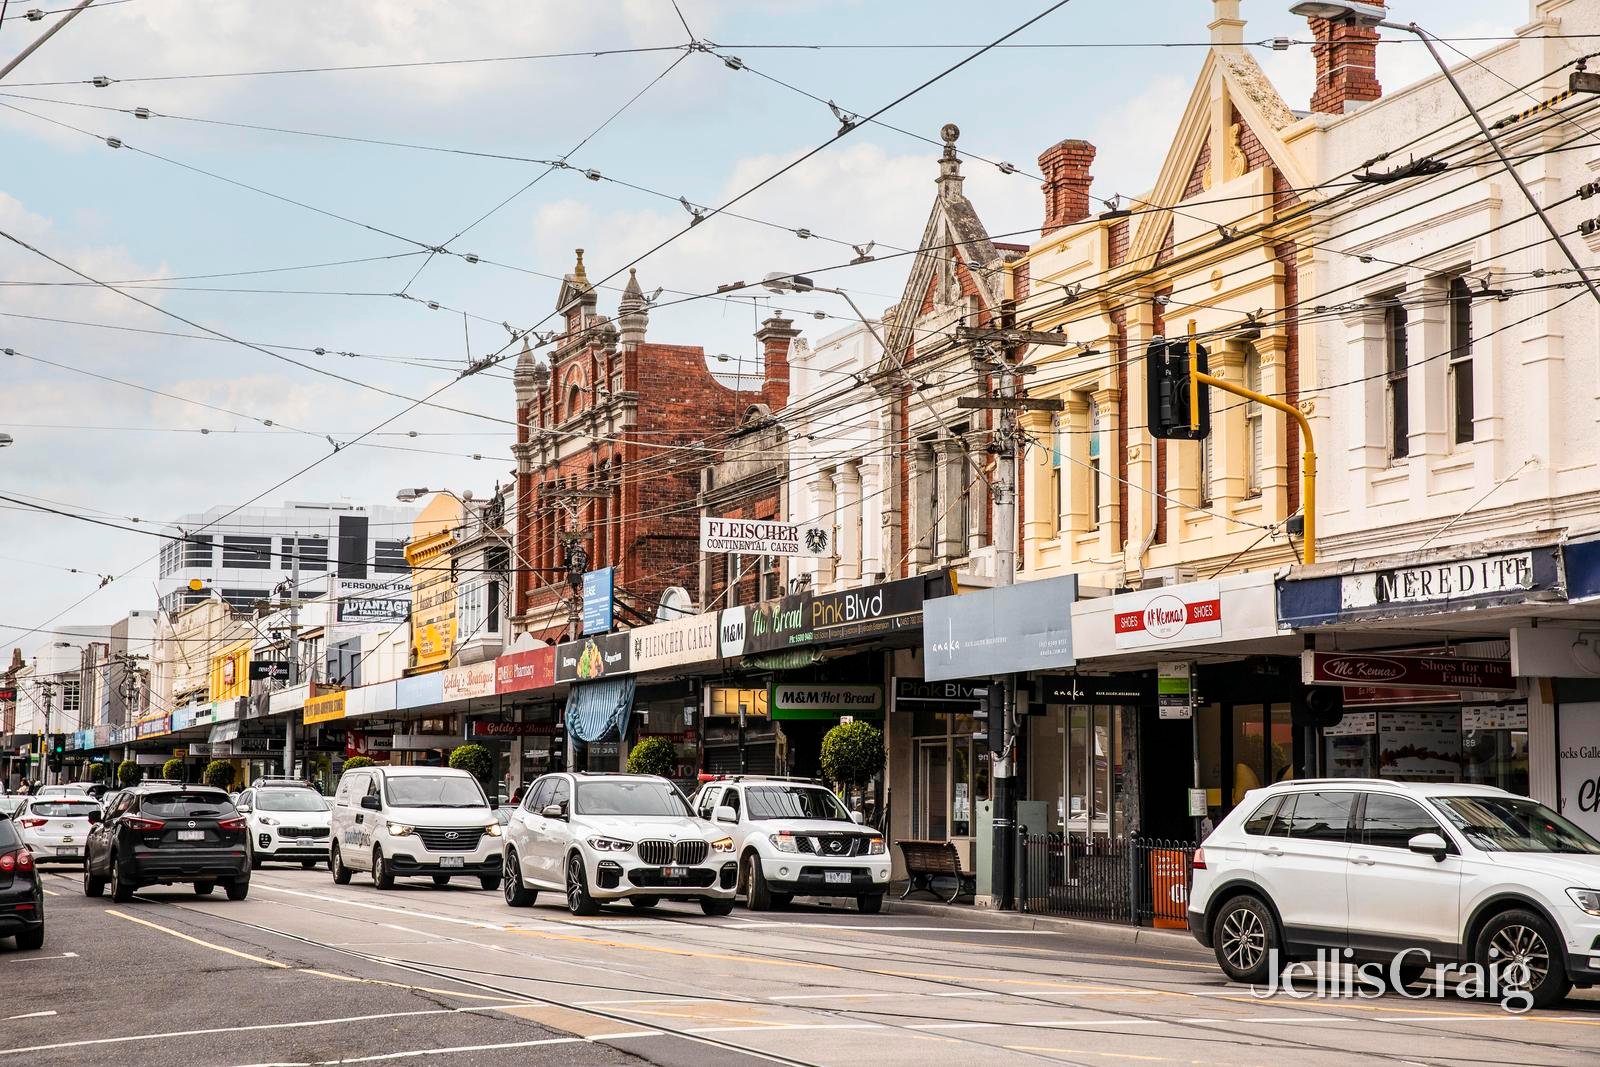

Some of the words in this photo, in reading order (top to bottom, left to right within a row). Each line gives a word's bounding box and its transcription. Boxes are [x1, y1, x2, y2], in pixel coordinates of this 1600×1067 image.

[708, 521, 800, 541] FLEISCHER
[707, 539, 767, 552] CONTINENTAL
[770, 542, 799, 553] CAKES
[341, 582, 388, 590] PERSONAL
[812, 598, 844, 627] Pink
[845, 589, 883, 620] Blvd
[1194, 605, 1213, 618] SHOES
[773, 602, 803, 633] Bread
[1121, 616, 1138, 628] SHOES
[722, 623, 744, 643] M&M
[932, 617, 960, 661] anaka
[645, 630, 684, 658] FLEISCHER
[688, 624, 713, 651] CAKES
[514, 664, 535, 678] Pharmacy
[1333, 661, 1353, 675] Mc
[1356, 662, 1397, 677] Kennas
[1420, 660, 1456, 672] Shoes
[1461, 661, 1480, 673] for
[1485, 662, 1504, 674] the
[443, 674, 466, 693] Goldy's
[466, 671, 493, 690] Boutique
[1442, 672, 1483, 687] Family
[901, 682, 942, 697] Pink
[945, 683, 975, 697] Blv
[1054, 679, 1085, 700] anaka
[781, 691, 820, 704] M&M
[820, 691, 840, 704] Hot
[842, 692, 875, 704] Bread
[487, 722, 521, 735] Goldy's
